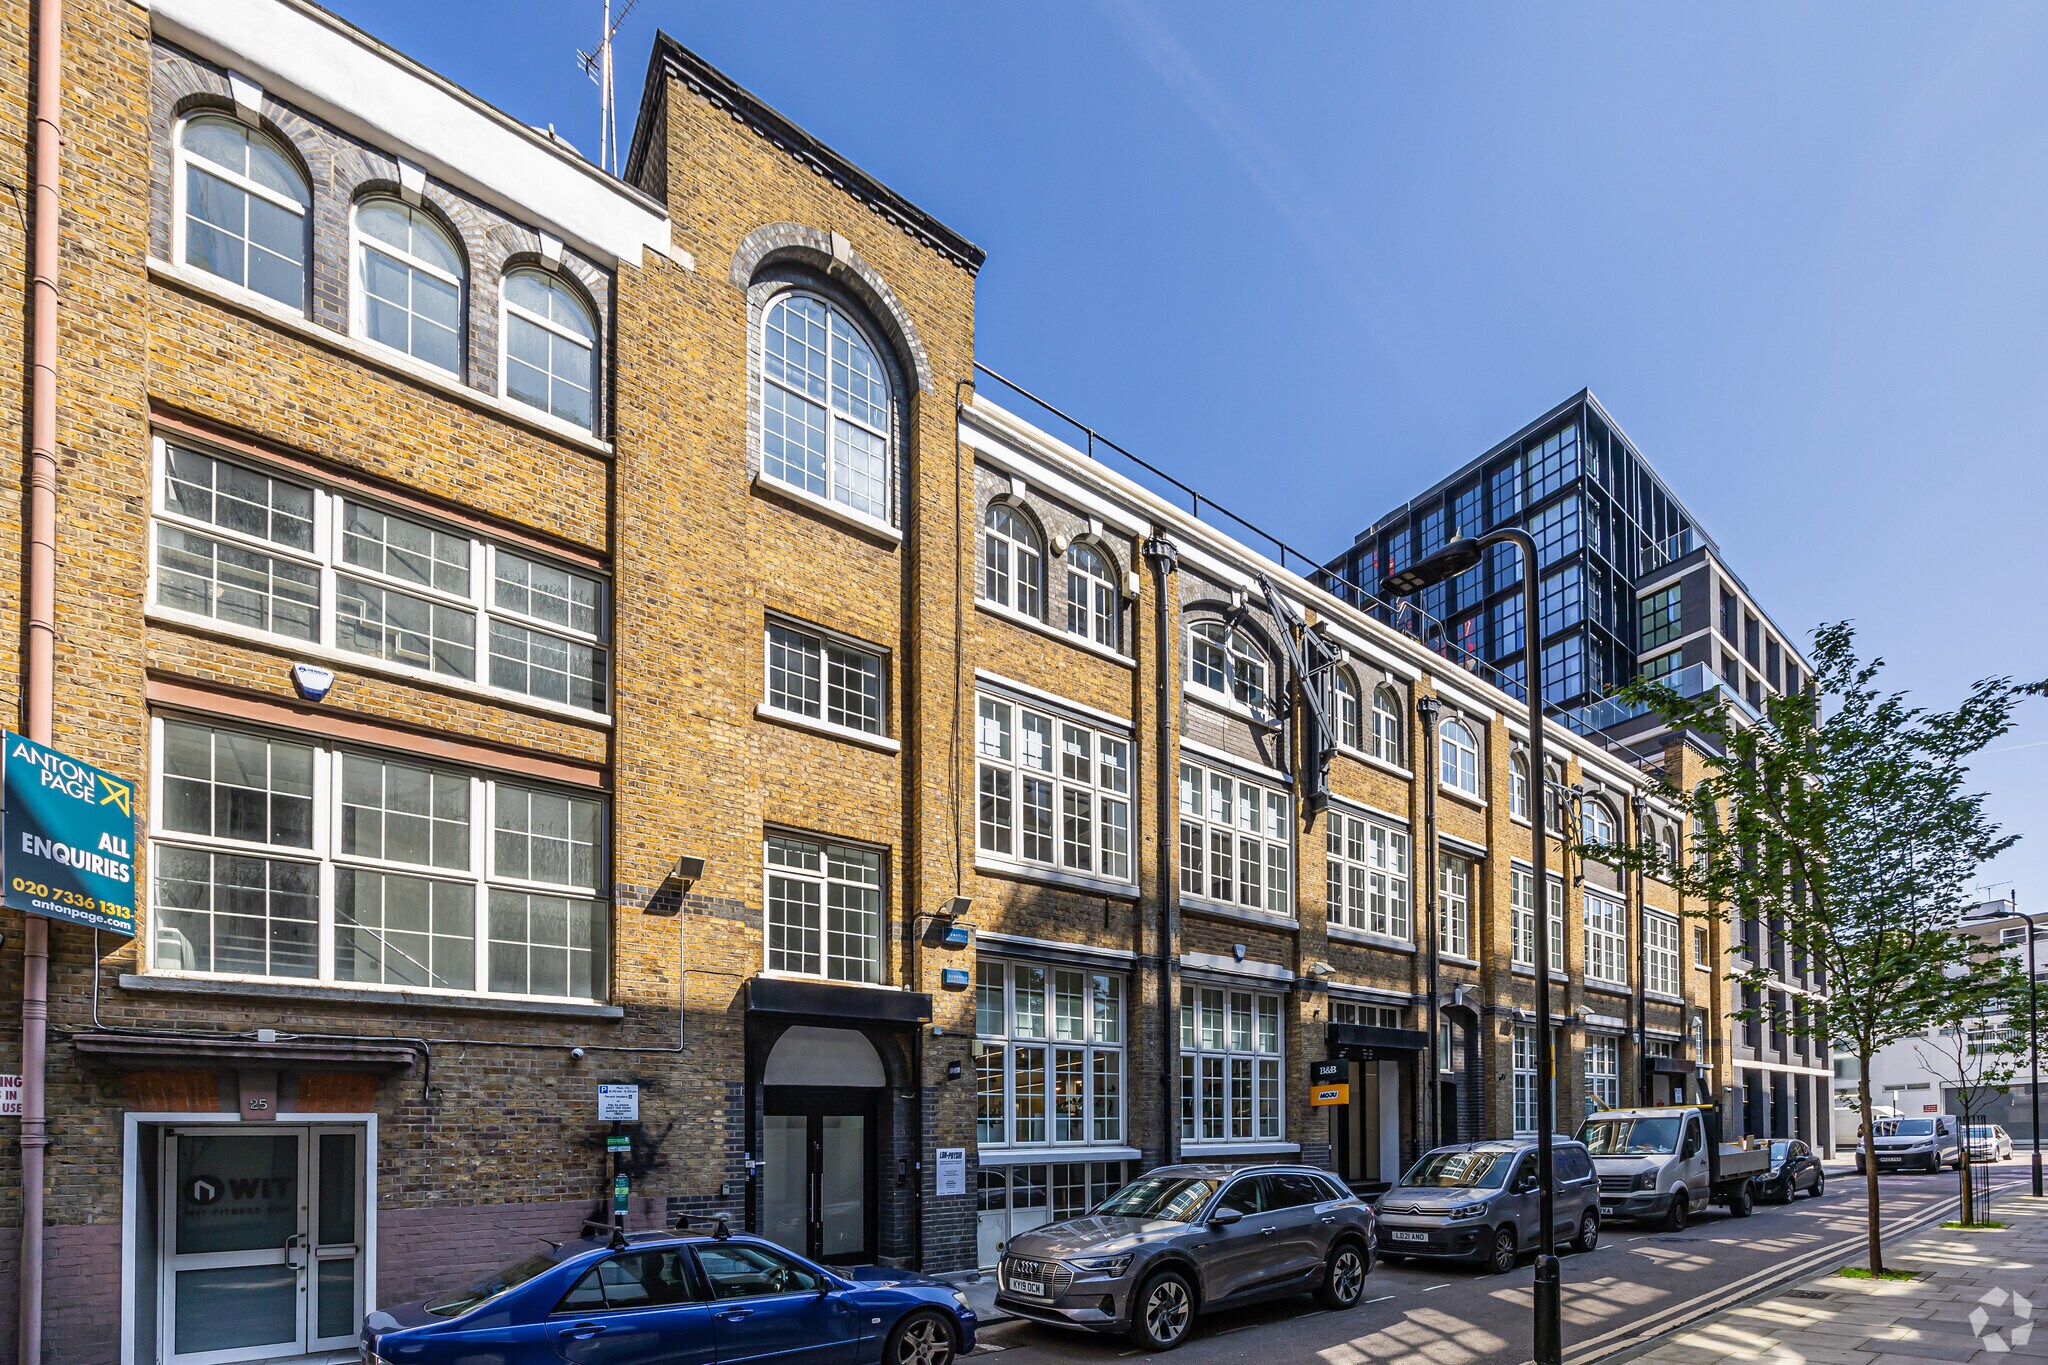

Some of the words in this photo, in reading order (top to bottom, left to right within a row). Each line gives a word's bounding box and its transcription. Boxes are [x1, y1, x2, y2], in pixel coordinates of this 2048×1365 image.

[12, 742, 95, 788] ANTON
[41, 769, 95, 804] PAGE
[22, 832, 130, 883] ENQUIRIES
[98, 832, 130, 859] ALL
[12, 877, 48, 897] 020
[52, 888, 96, 909] 7336
[99, 900, 131, 919] 1313
[31, 898, 131, 930] antonpage.com
[1319, 1065, 1337, 1075] B&B
[5, 1090, 17, 1100] IN
[249, 1098, 268, 1110] 25
[1319, 1091, 1338, 1099] MOJU
[2, 1103, 22, 1113] USE
[228, 1176, 293, 1200] WIT
[1013, 1279, 1027, 1291] KY19
[1027, 1282, 1041, 1294] OCM
